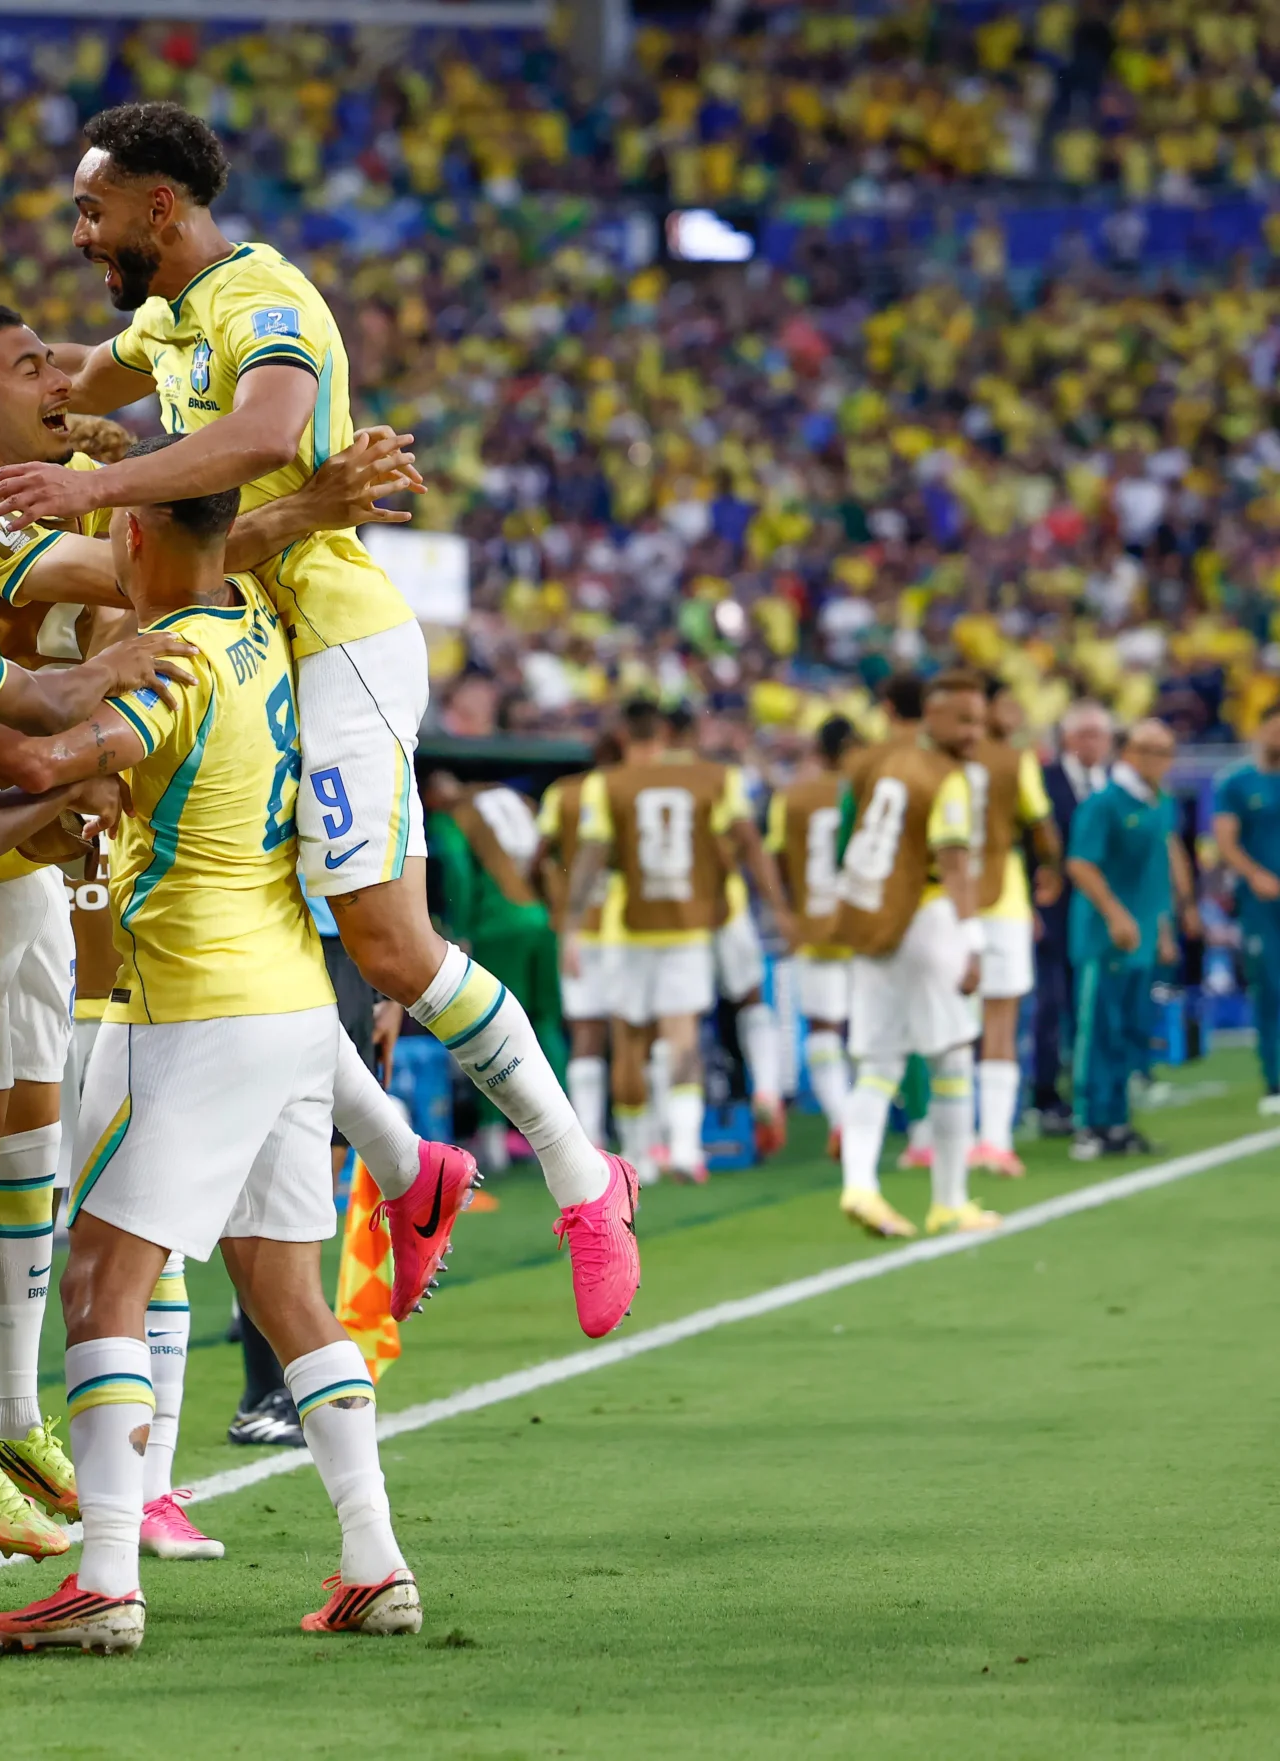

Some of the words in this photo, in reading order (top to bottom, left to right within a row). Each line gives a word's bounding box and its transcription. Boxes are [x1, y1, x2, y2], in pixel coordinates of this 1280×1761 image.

[188, 397, 221, 411] BRASIL
[262, 671, 302, 852] 8
[310, 767, 353, 840] 9
[486, 1056, 524, 1089] BRASIL
[150, 1345, 185, 1357] BRASIL
